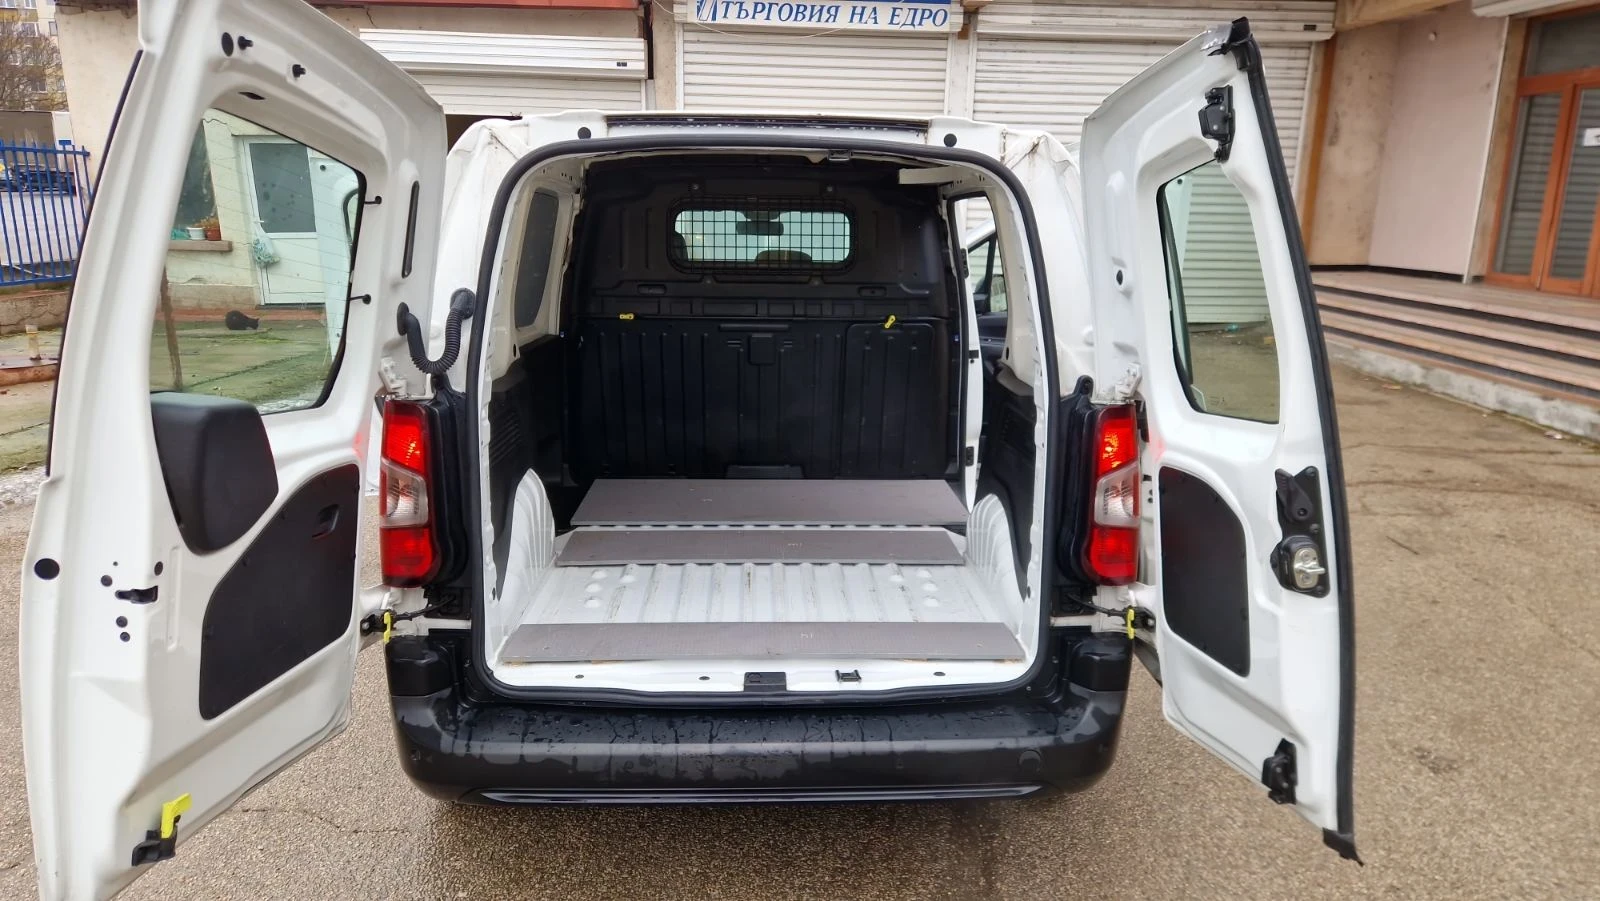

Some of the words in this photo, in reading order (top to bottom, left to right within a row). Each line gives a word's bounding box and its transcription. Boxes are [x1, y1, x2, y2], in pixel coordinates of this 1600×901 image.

[721, 1, 841, 24] ТЪРГОВИЯ
[848, 5, 879, 25] НА
[888, 7, 949, 29] ЕДРО
